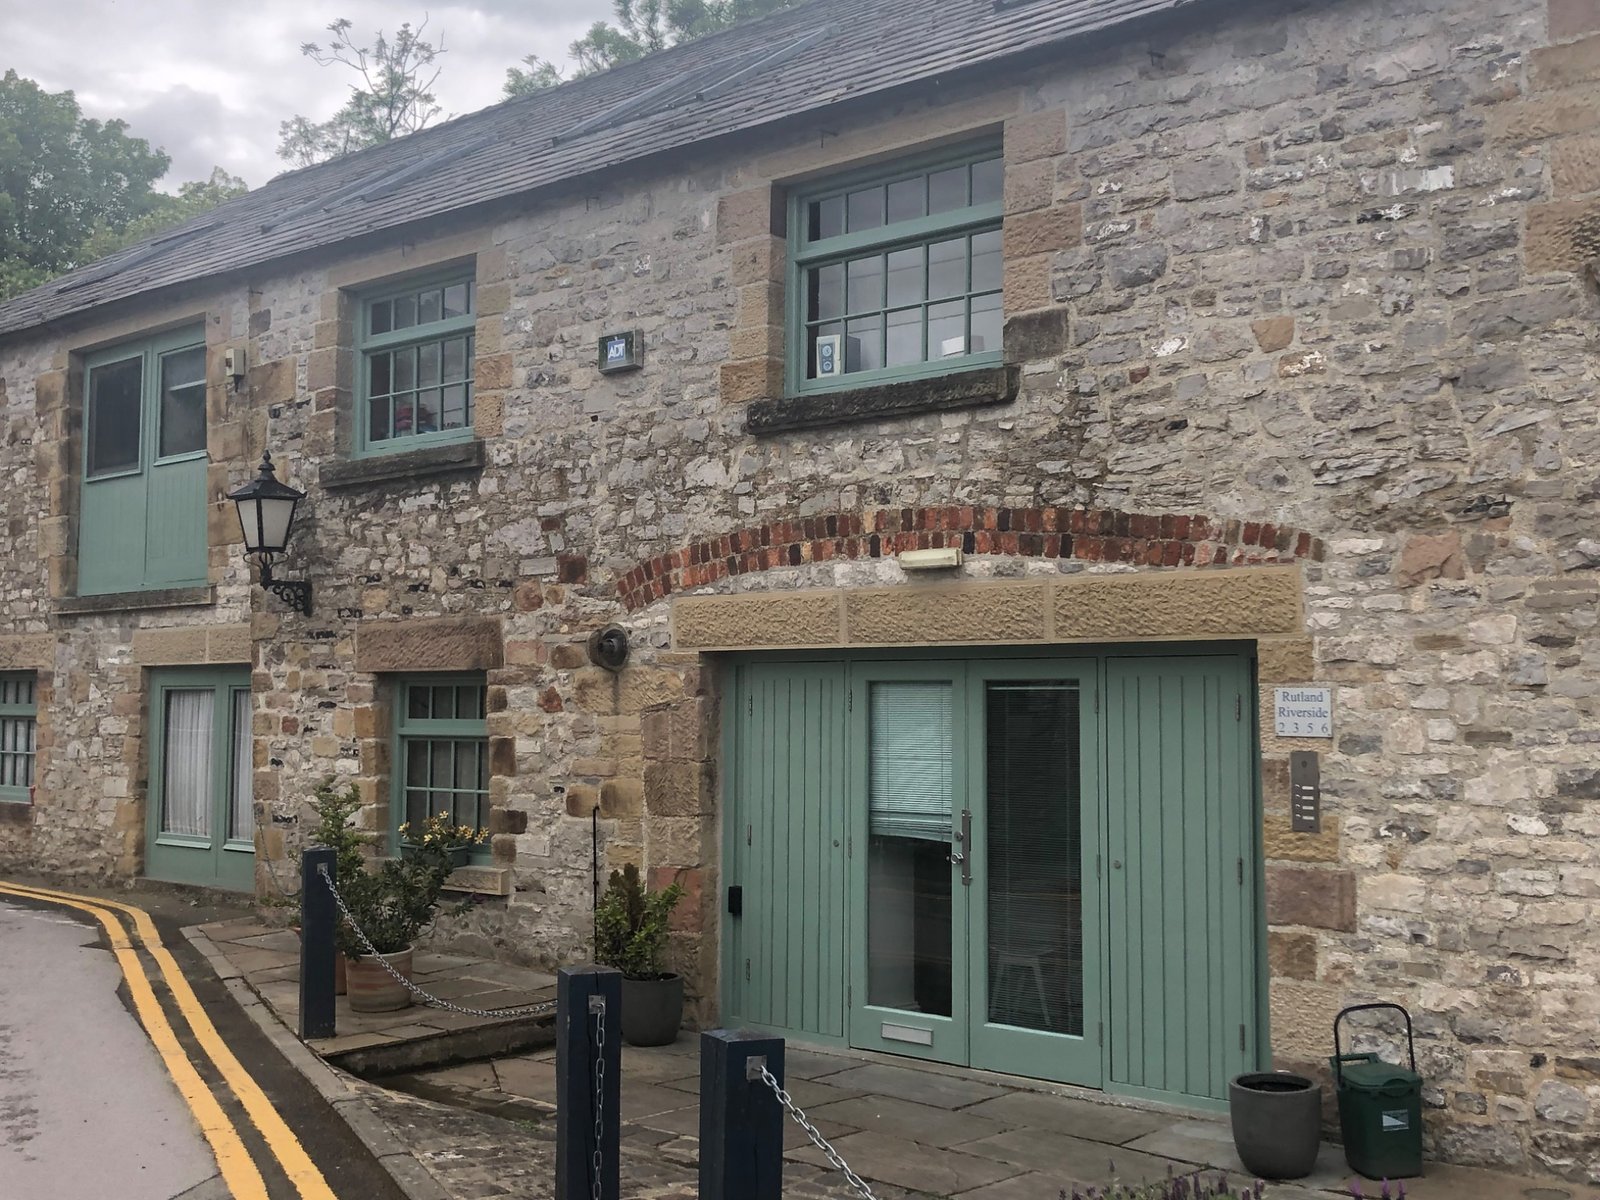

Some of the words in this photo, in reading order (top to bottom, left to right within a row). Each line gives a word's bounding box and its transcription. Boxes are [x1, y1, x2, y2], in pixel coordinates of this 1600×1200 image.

[608, 344, 625, 358] ADT
[1282, 691, 1324, 702] Rutland
[1278, 706, 1329, 718] Riverside
[1278, 722, 1285, 733] 2
[1292, 722, 1299, 733] 3
[1307, 722, 1314, 734] 5
[1321, 722, 1329, 734] 6
